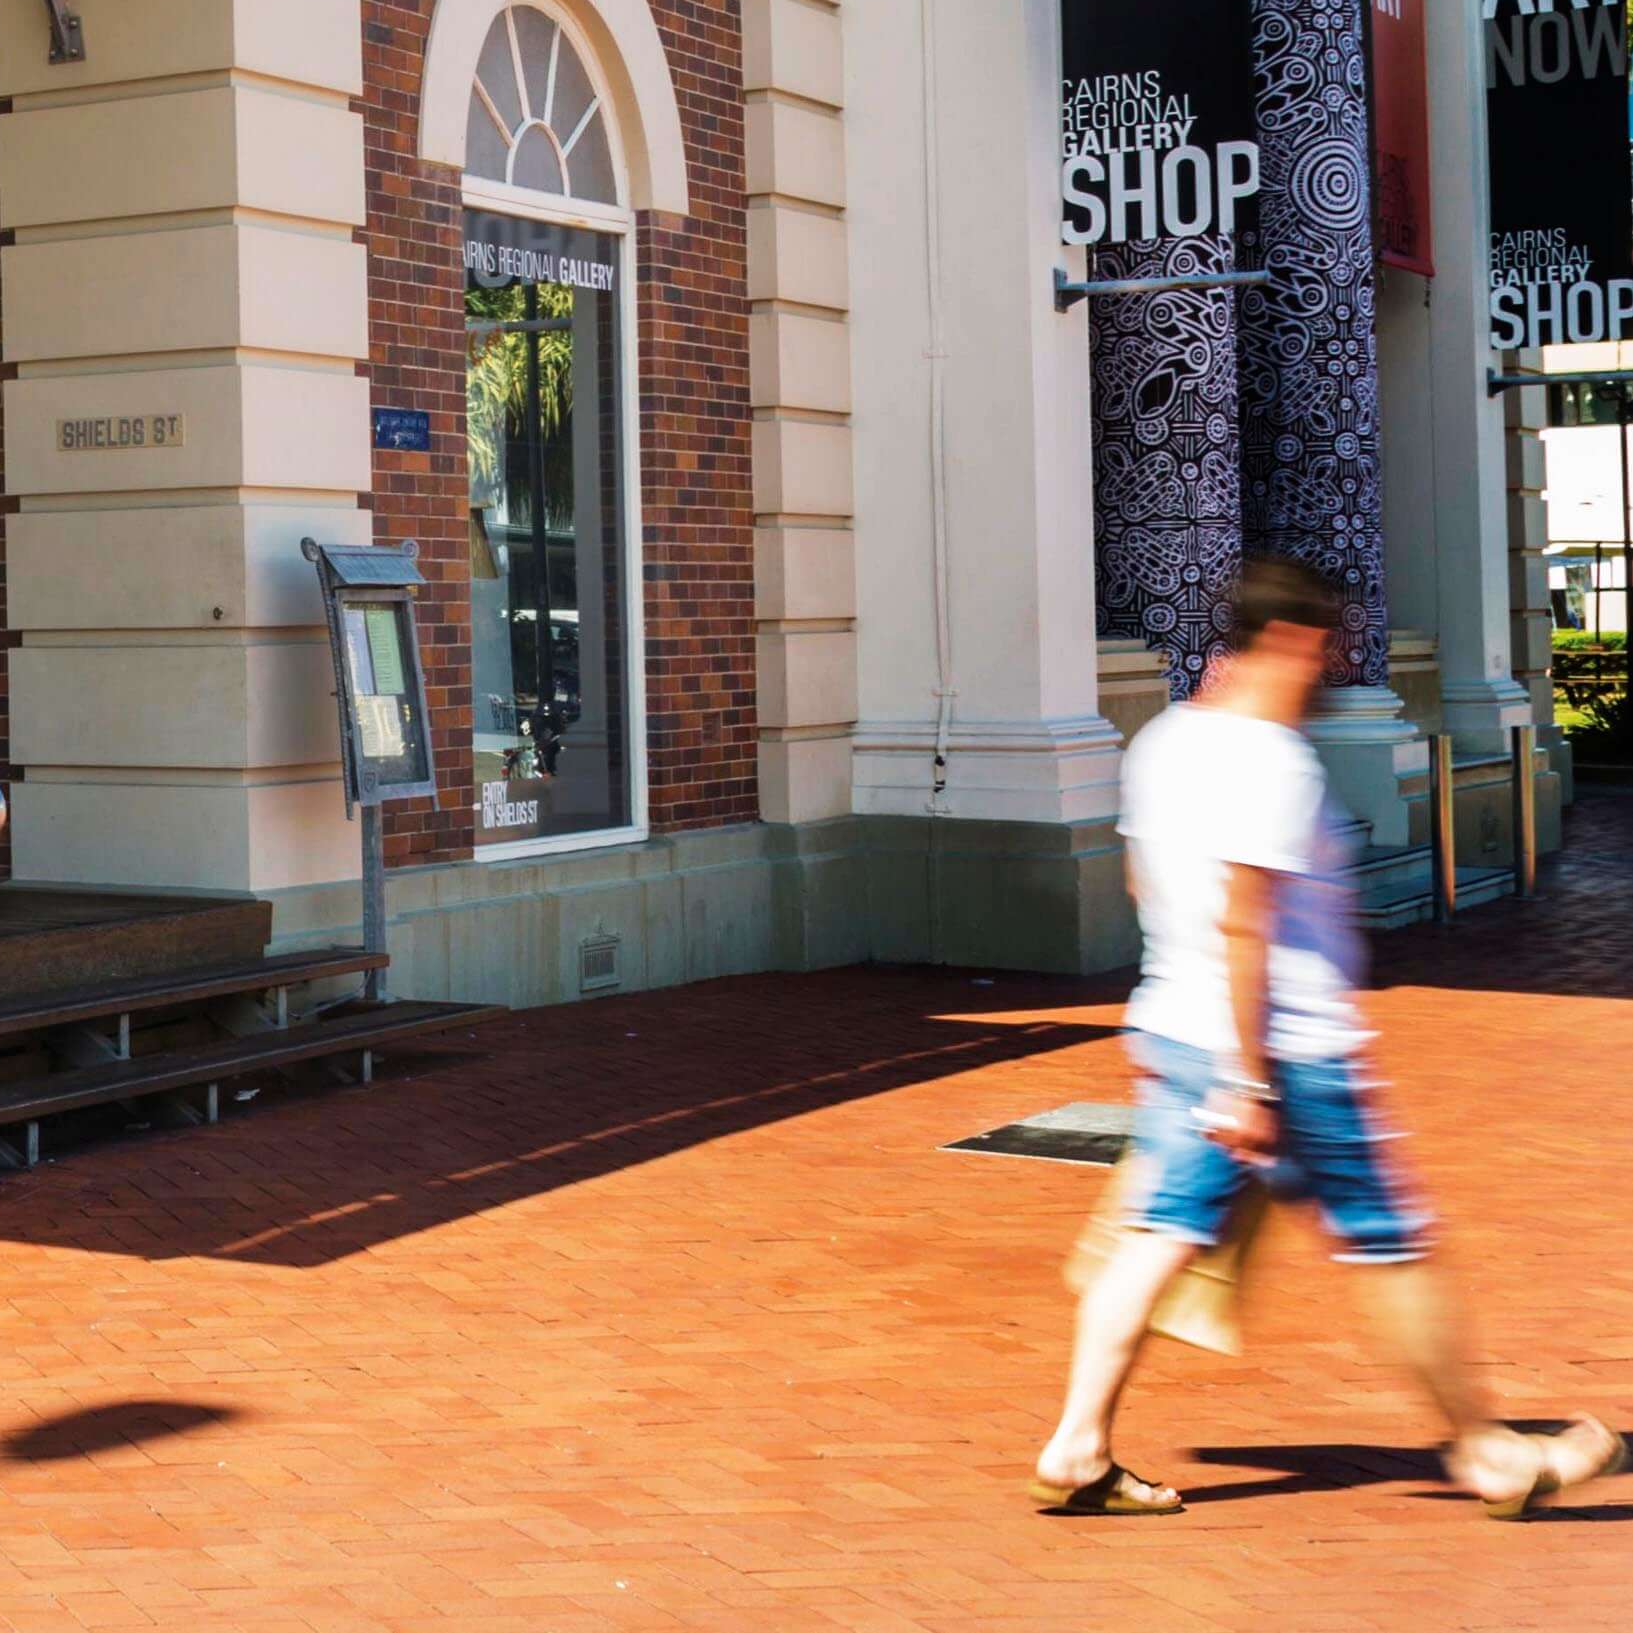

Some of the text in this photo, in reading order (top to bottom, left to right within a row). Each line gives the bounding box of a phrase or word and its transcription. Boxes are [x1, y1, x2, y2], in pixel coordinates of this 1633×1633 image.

[1485, 4, 1628, 89] NOW
[1063, 120, 1194, 157] GALLERY
[1063, 140, 1260, 245] SHOP
[1490, 227, 1566, 250] CAIRNS
[498, 246, 557, 282] REGIONAL
[559, 257, 614, 291] GALLERY
[1489, 245, 1594, 269] REGIONAL
[1491, 264, 1590, 287] GALLERY
[1490, 279, 1633, 350] SHOP
[62, 417, 177, 448] SHIELDS ST
[483, 780, 507, 805] ENTRY
